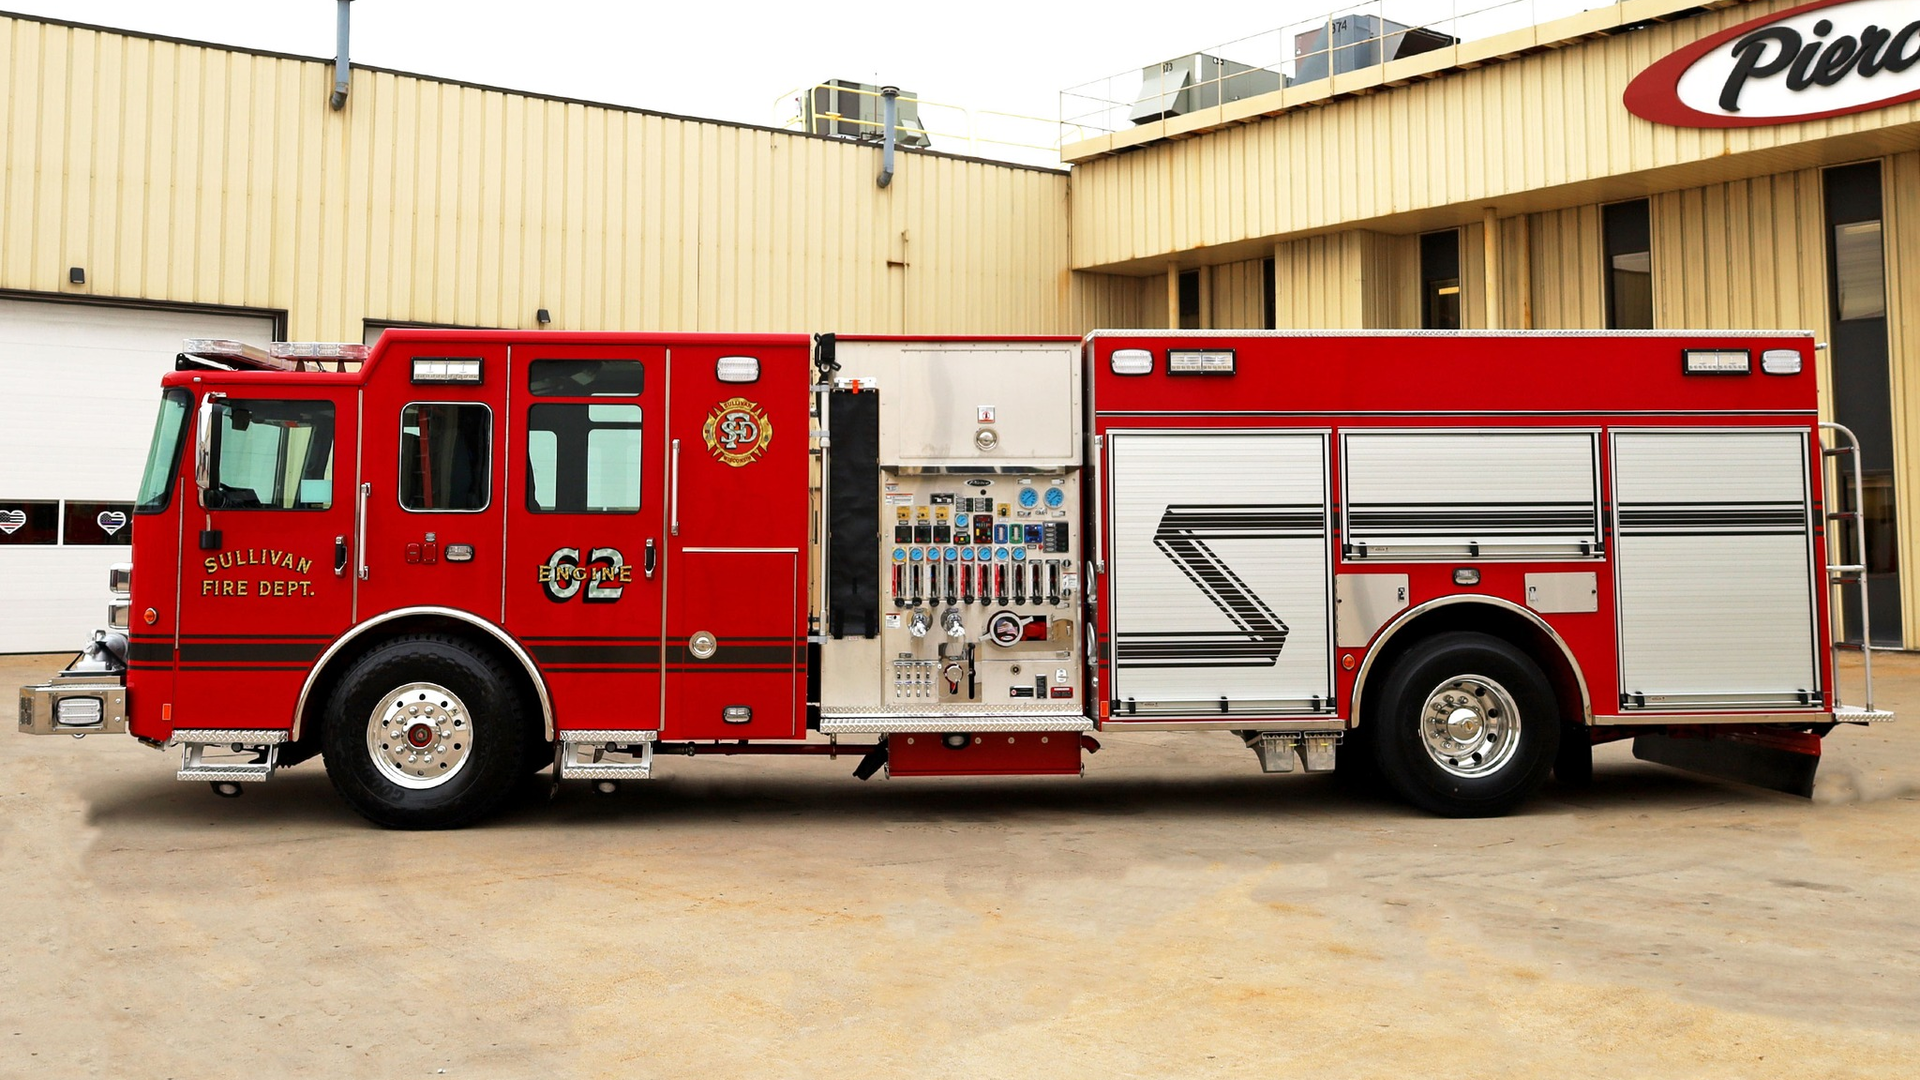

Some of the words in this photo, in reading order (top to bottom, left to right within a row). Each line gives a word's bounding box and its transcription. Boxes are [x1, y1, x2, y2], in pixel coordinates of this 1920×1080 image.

[204, 549, 313, 575] SULLIVAN
[538, 565, 632, 583] ENGINE
[547, 547, 624, 600] 62
[202, 580, 248, 596] FIRE
[259, 580, 315, 596] DEPT.
